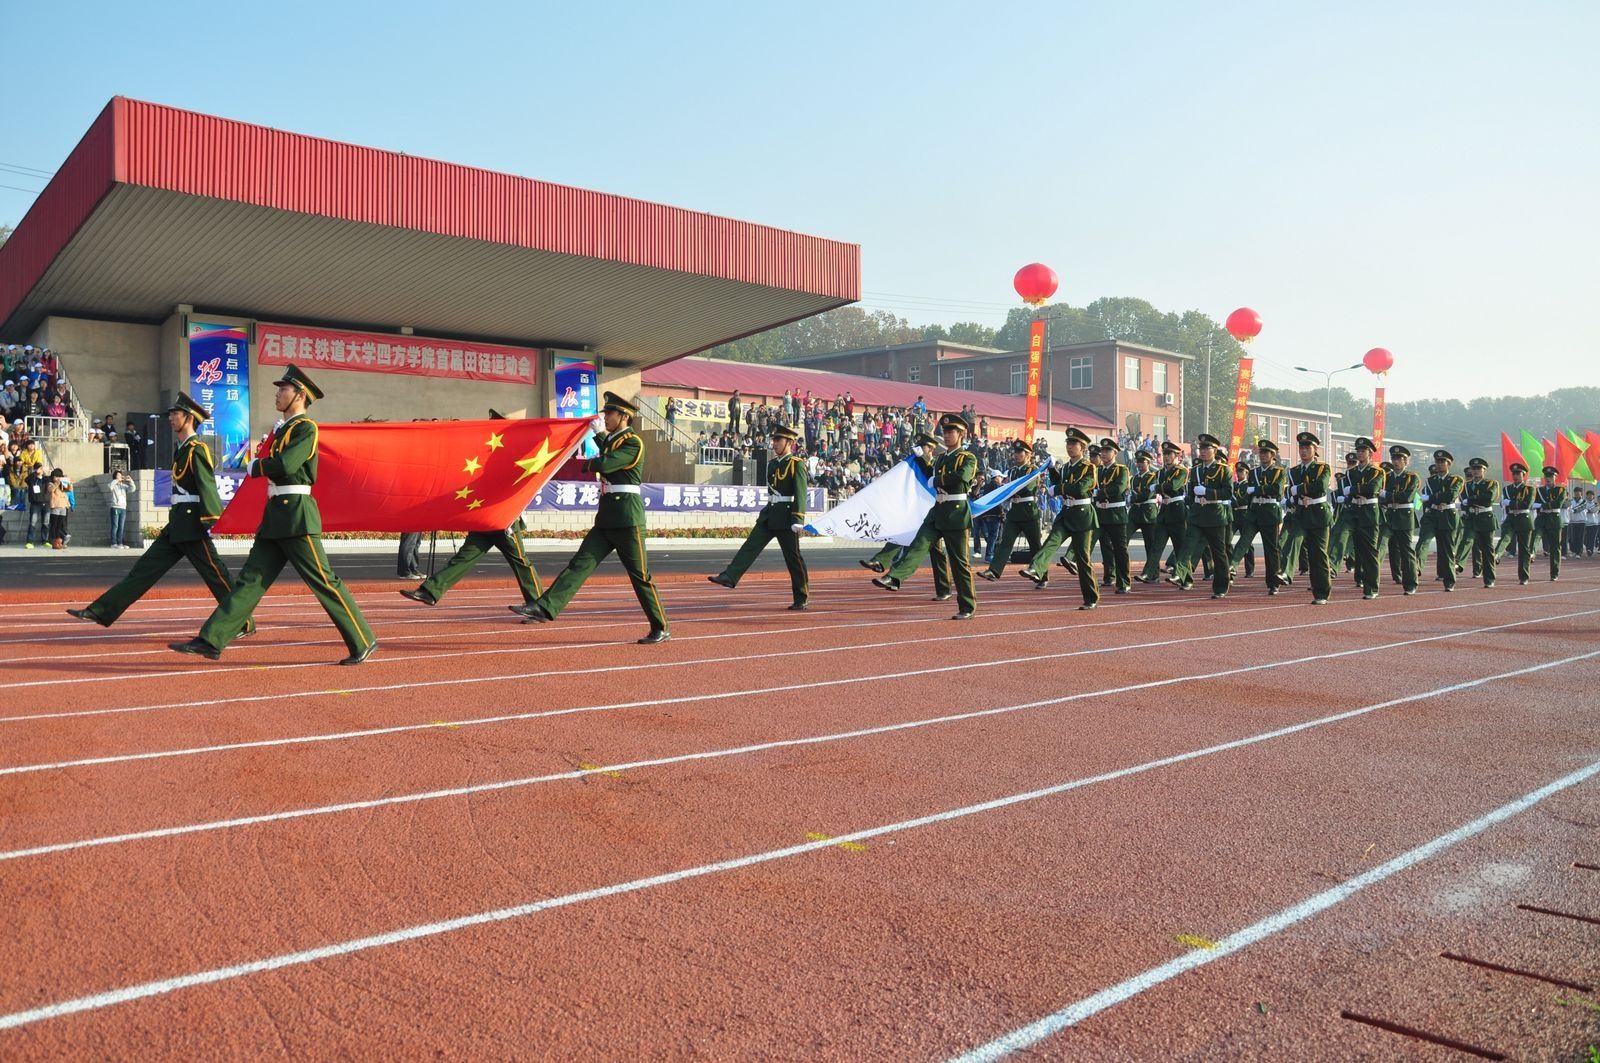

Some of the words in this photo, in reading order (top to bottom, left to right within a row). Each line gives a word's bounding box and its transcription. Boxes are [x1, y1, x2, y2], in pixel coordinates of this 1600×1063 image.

[225, 342, 239, 402] 指点赛场
[264, 333, 530, 377] 石家庄铁道大学四方学院首届田径运动会
[1029, 334, 1041, 397] 自强不息
[1235, 368, 1250, 420] 赛出成绩
